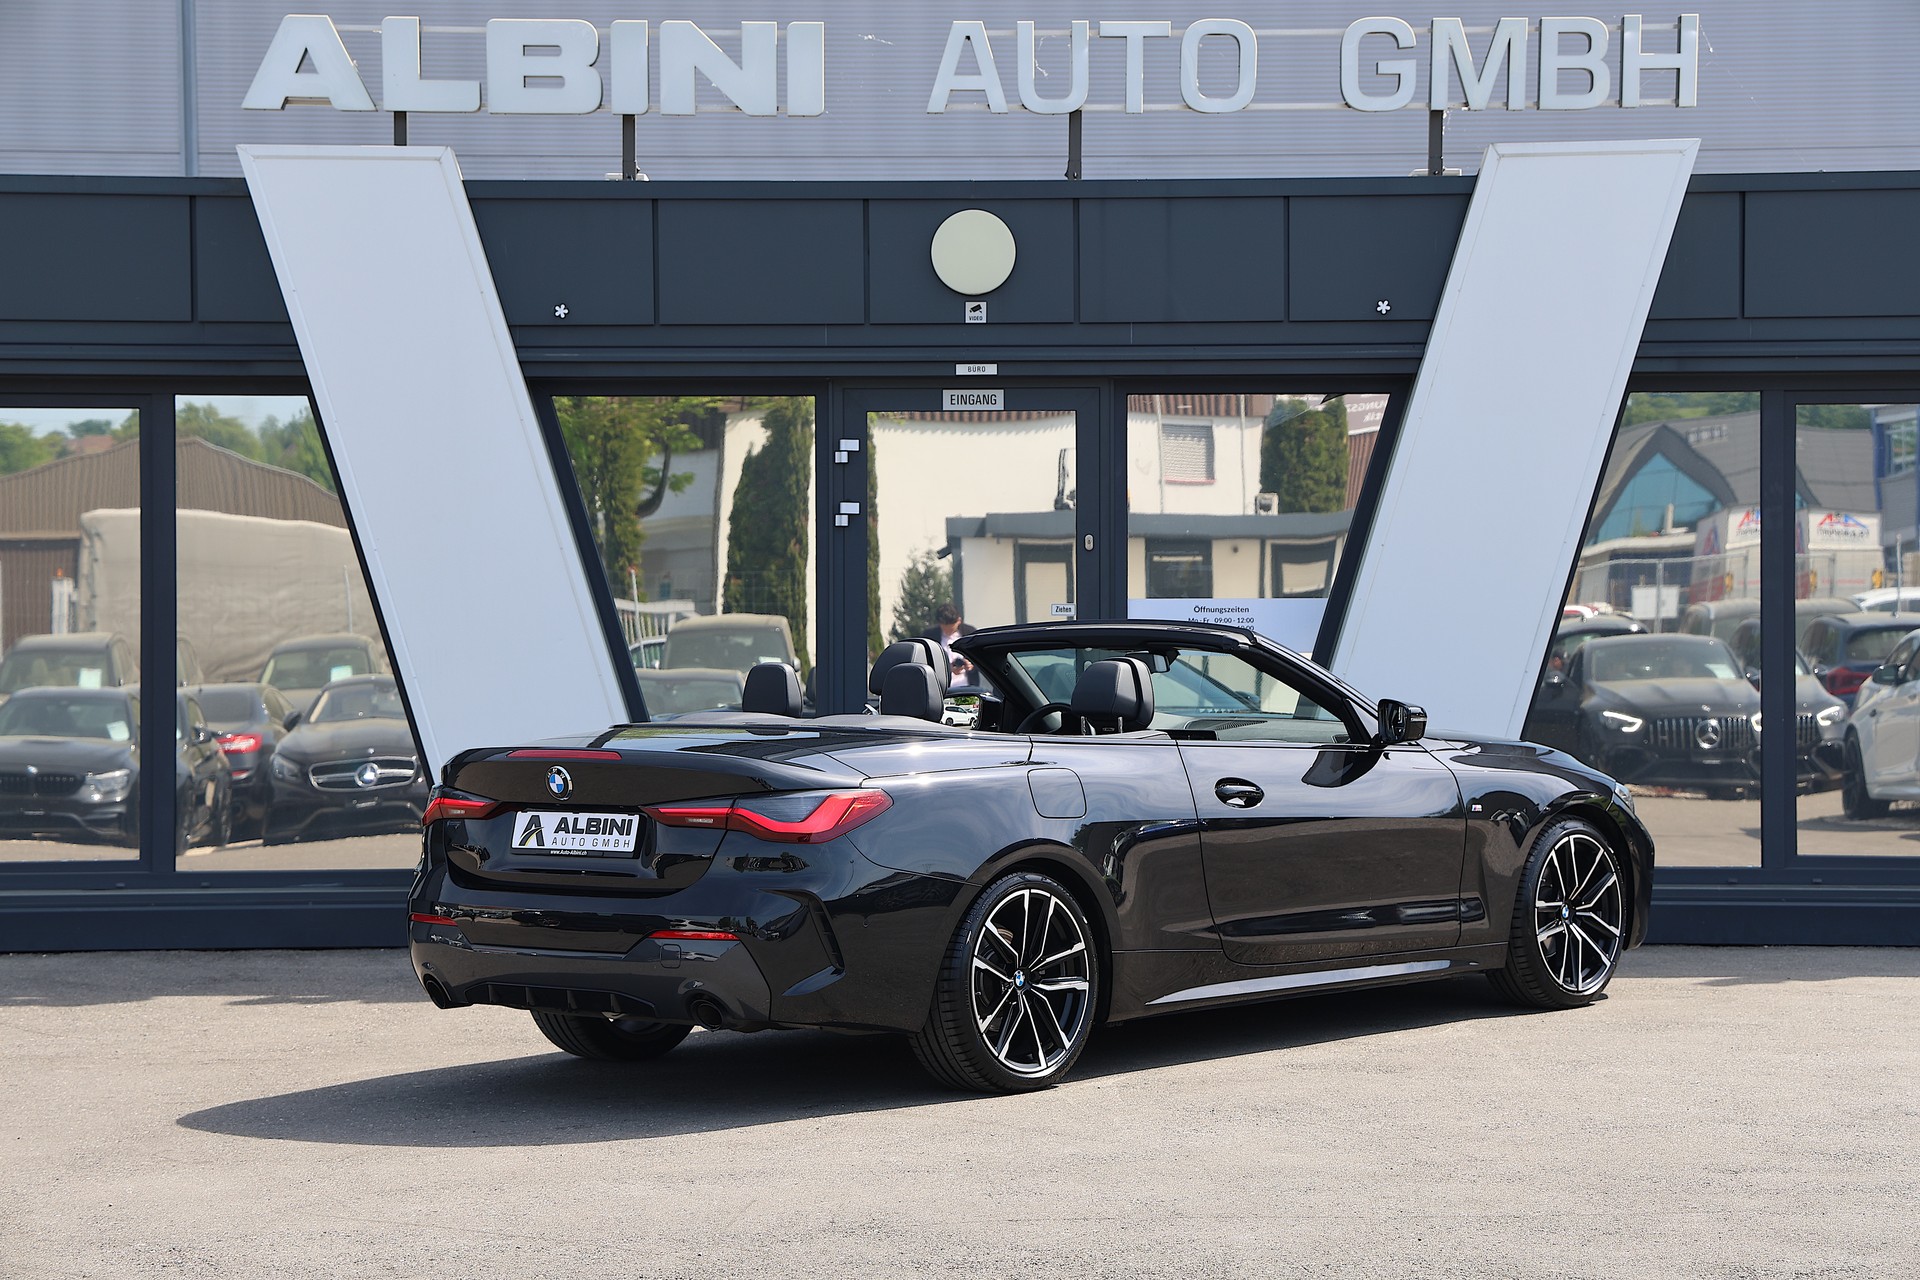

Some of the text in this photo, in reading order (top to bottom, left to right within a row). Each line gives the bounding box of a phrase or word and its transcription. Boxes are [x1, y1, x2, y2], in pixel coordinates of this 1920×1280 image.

[241, 13, 1700, 117] ALBINI AUTO GMBH
[967, 365, 986, 373] BÜRO
[950, 394, 997, 406] EINGANG
[1055, 605, 1072, 613] Ziehen
[1193, 605, 1250, 614] Öffnungszeiten
[553, 817, 633, 836] ALBINI
[551, 836, 630, 848] AUTO GMBH
